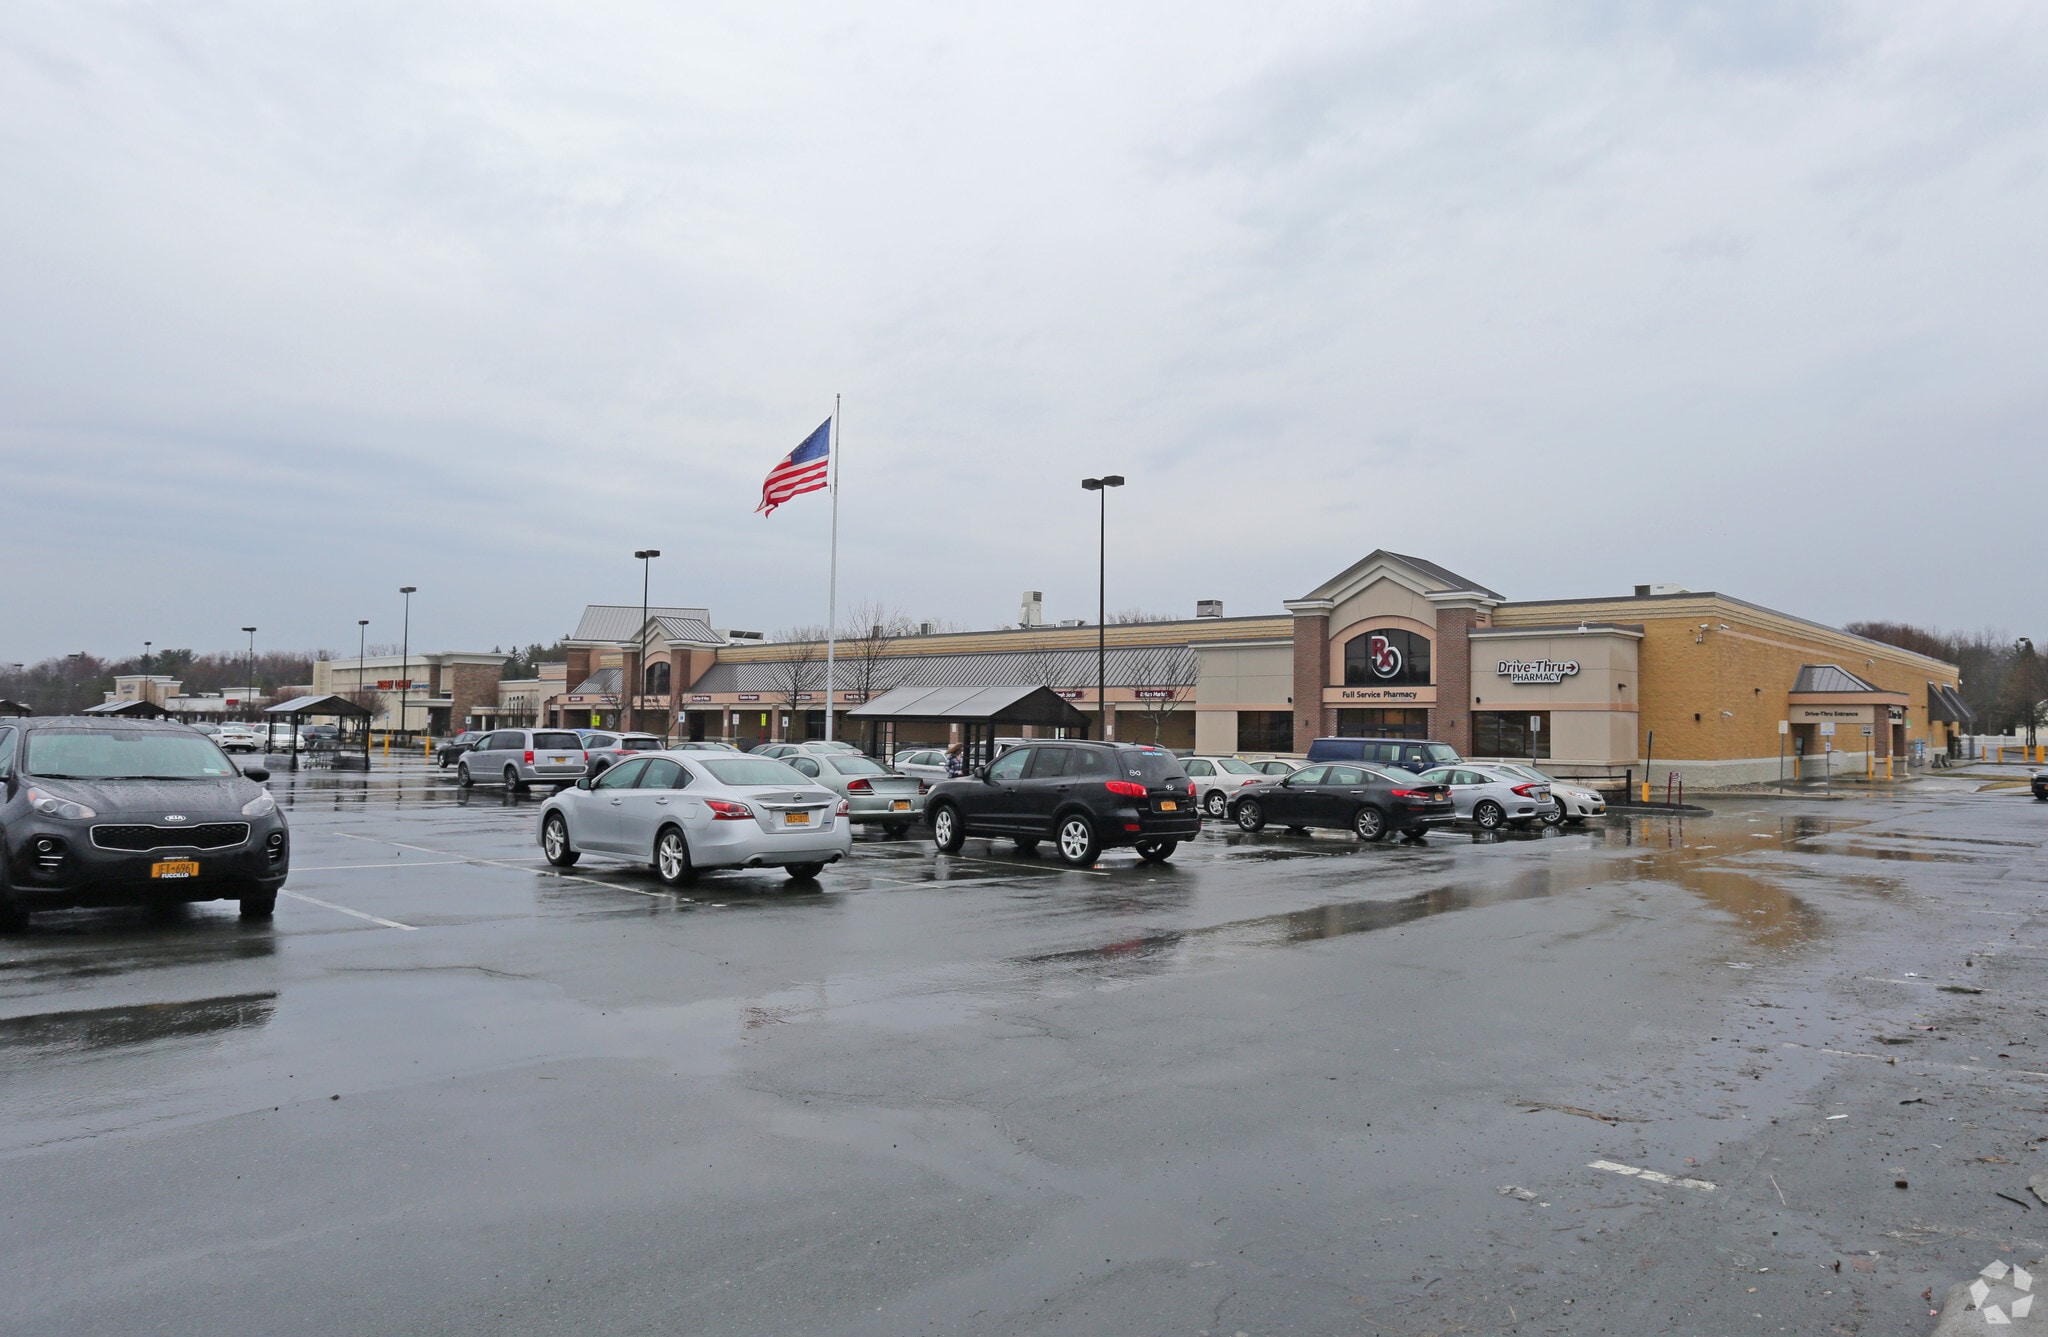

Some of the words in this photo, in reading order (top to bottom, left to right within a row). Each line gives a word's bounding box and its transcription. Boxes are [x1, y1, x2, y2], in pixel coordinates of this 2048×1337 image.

[1498, 661, 1565, 672] Drive-Thru
[1512, 673, 1561, 681] PHARMACY
[1383, 691, 1417, 699] Pharmacy
